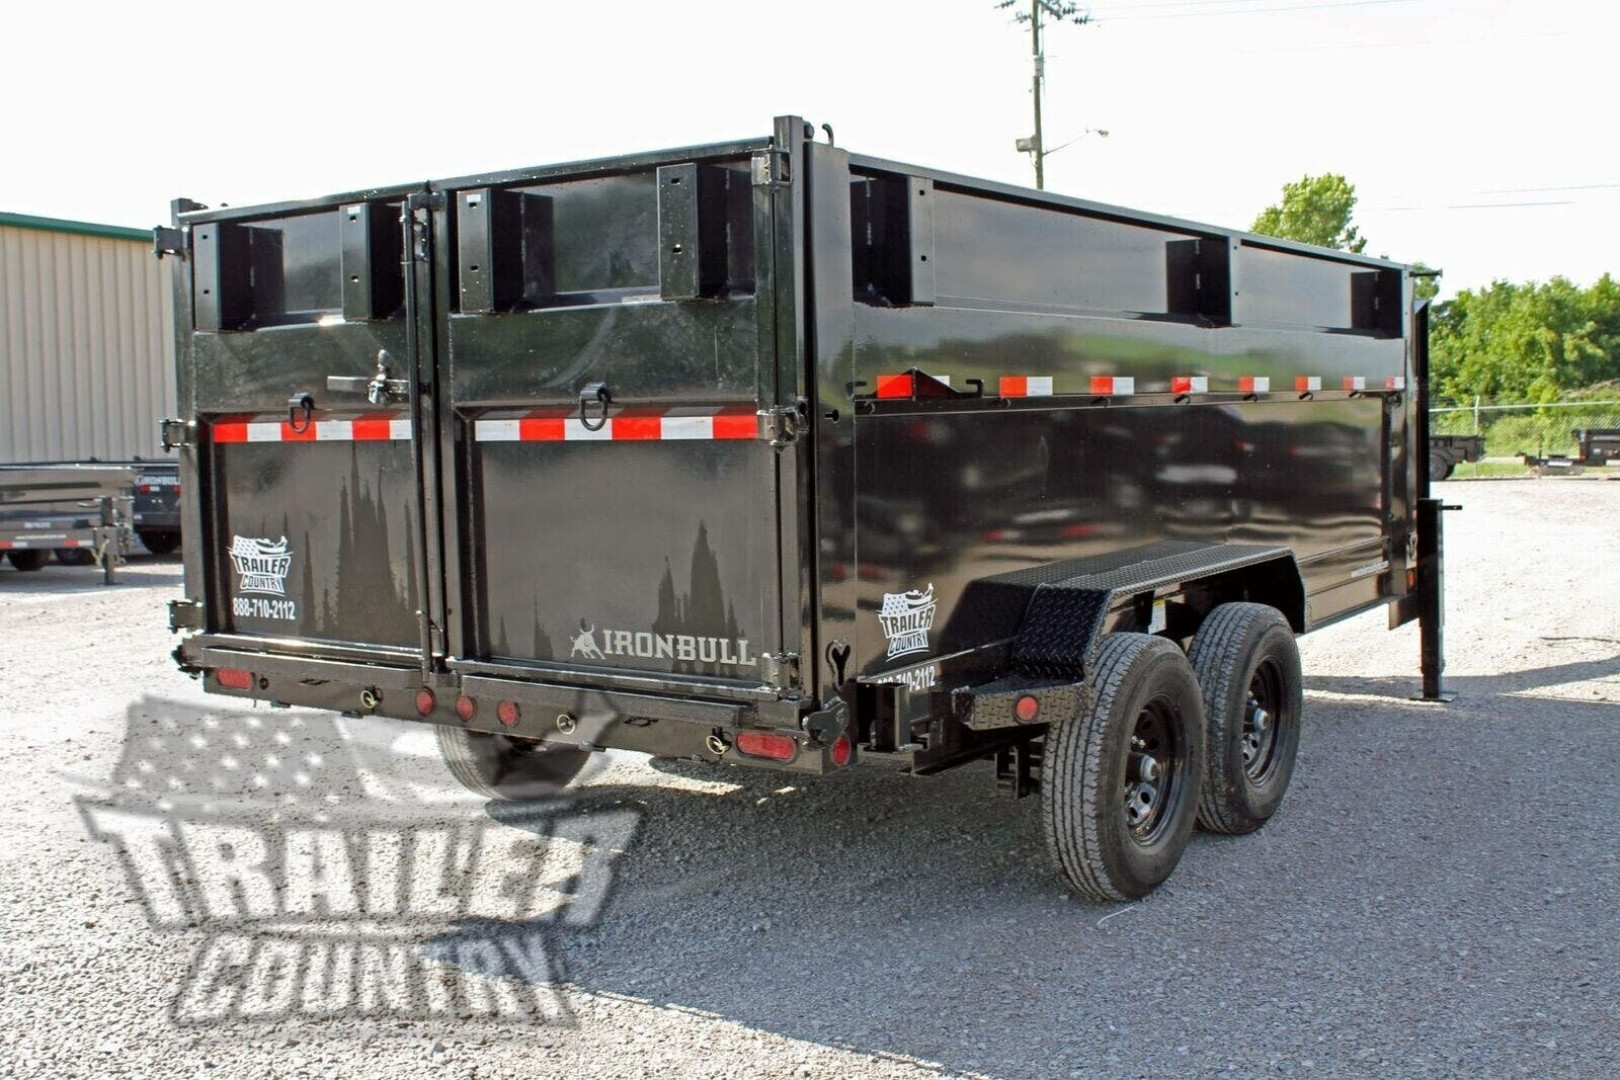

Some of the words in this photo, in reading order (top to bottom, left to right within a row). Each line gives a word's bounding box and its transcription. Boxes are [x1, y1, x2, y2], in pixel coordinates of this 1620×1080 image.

[230, 553, 290, 577] TRAILER
[241, 574, 285, 592] COUNTRY
[233, 597, 296, 620] 888-710-2112
[879, 606, 935, 636] TRAILER
[602, 629, 757, 666] IRONBULL
[889, 630, 929, 654] COUNTRY
